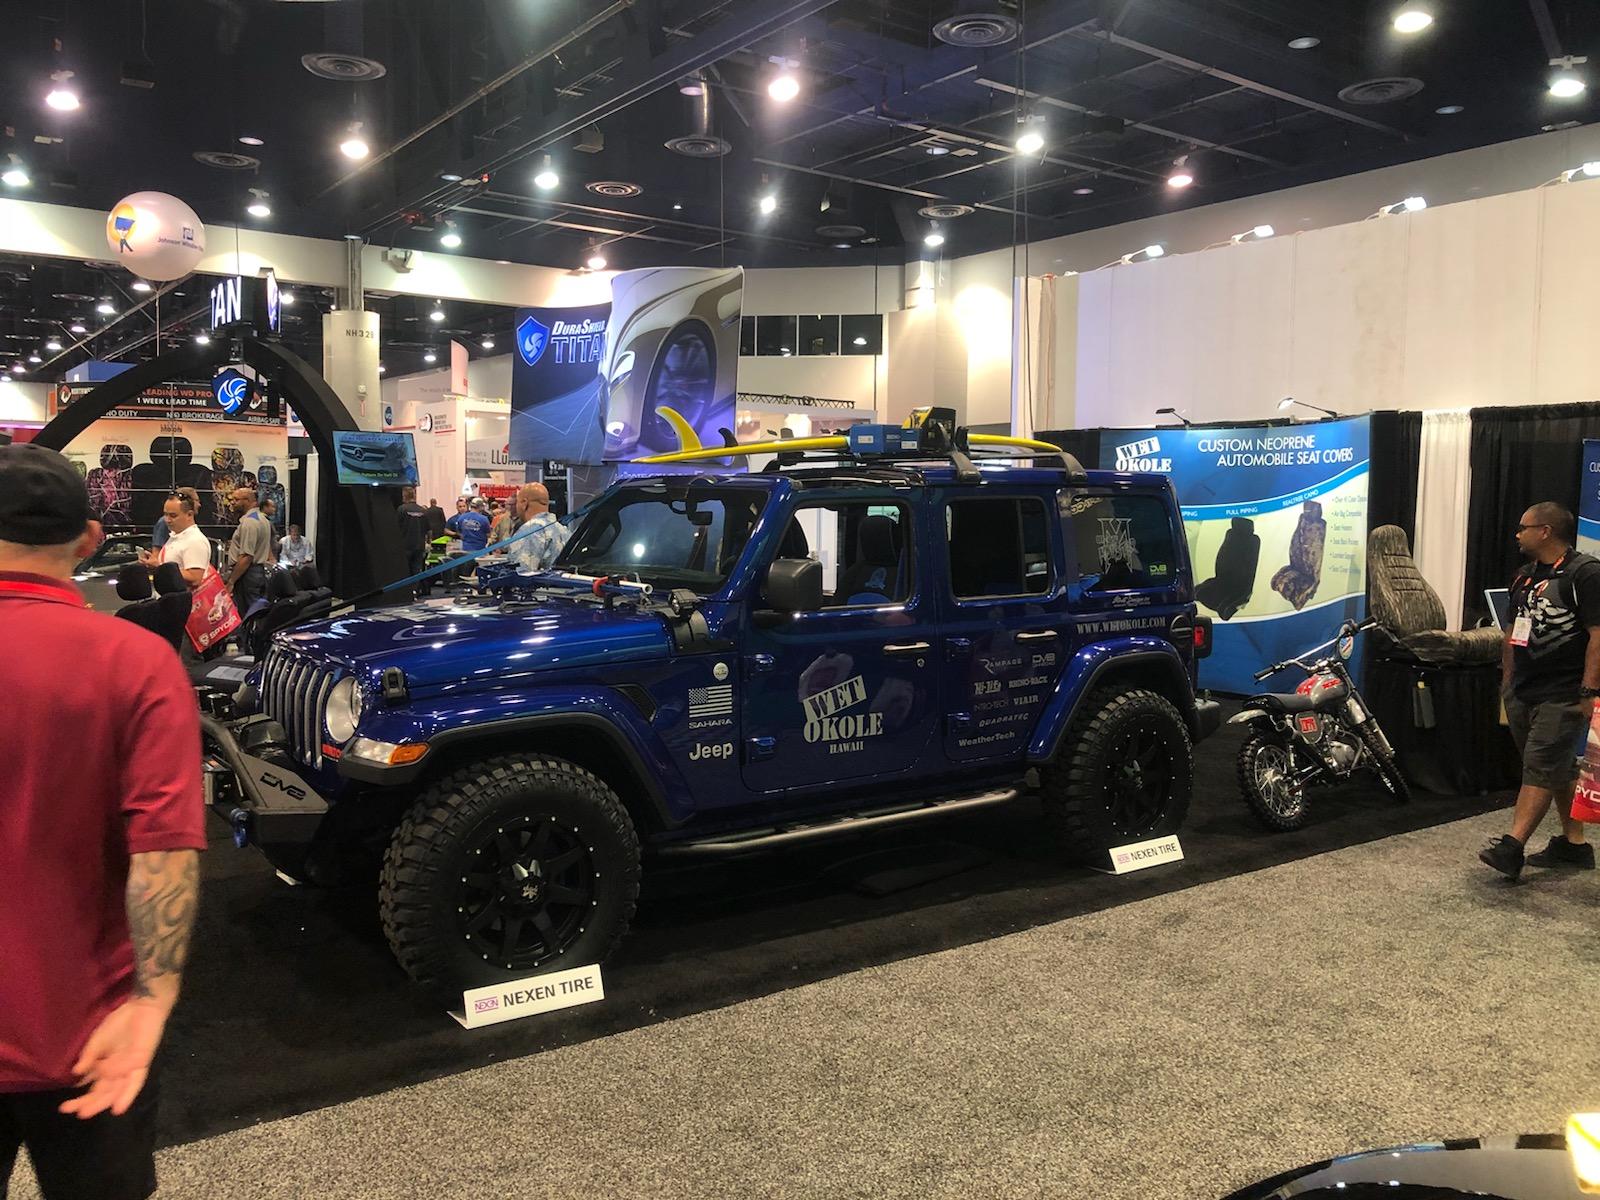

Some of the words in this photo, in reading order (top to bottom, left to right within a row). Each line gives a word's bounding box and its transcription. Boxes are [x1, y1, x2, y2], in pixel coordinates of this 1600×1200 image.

[142, 397, 164, 405] WEEK
[189, 399, 208, 407] TIME
[118, 410, 139, 418] DUTY
[1119, 439, 1157, 459] WET
[1197, 438, 1253, 453] CUSTOM
[1256, 434, 1316, 451] NEOPRENE
[1115, 457, 1172, 472] OKOLE
[1216, 452, 1295, 467] AUTOMOBILE
[1296, 450, 1321, 465] SEAT
[1322, 446, 1354, 464] COVERS
[1225, 508, 1240, 516] FULL
[808, 679, 860, 719] WET
[1013, 694, 1040, 705] VIAIR
[688, 717, 734, 730] SAHARA
[803, 712, 884, 744] OKOLE
[958, 730, 1016, 747] WeatherTech
[689, 742, 734, 761] Jeep
[829, 741, 865, 755] HAWAII
[1131, 846, 1159, 861] NEXEN
[1157, 842, 1178, 855] TIRE
[503, 984, 556, 1007] NEXEN
[559, 976, 594, 995] TIRE
